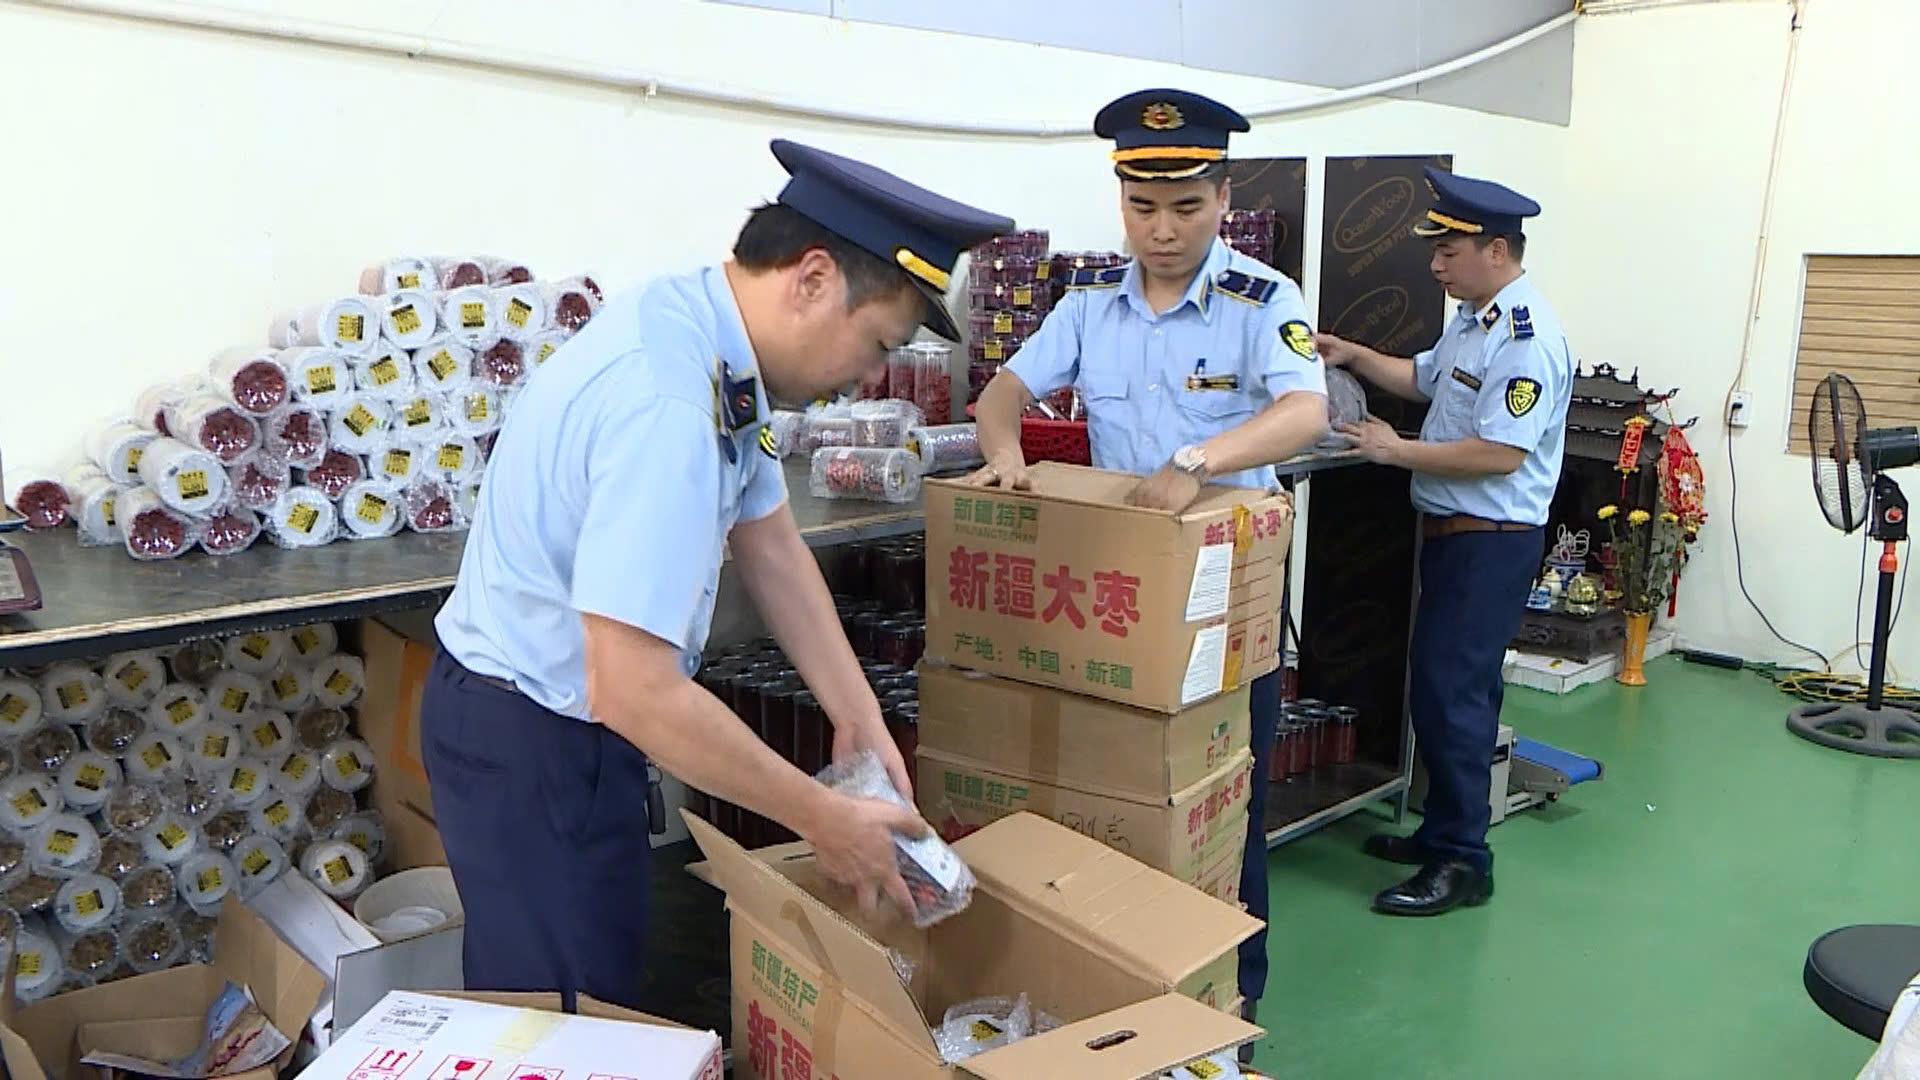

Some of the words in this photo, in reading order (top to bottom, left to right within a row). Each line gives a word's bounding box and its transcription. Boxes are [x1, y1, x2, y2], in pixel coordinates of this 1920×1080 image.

[953, 497, 1038, 529] 新疆特产
[949, 544, 1141, 638] 新疆大枣
[944, 770, 1029, 807] 新疆特产
[752, 939, 819, 1008] 新疆特产
[747, 1000, 840, 1080] 新疆
